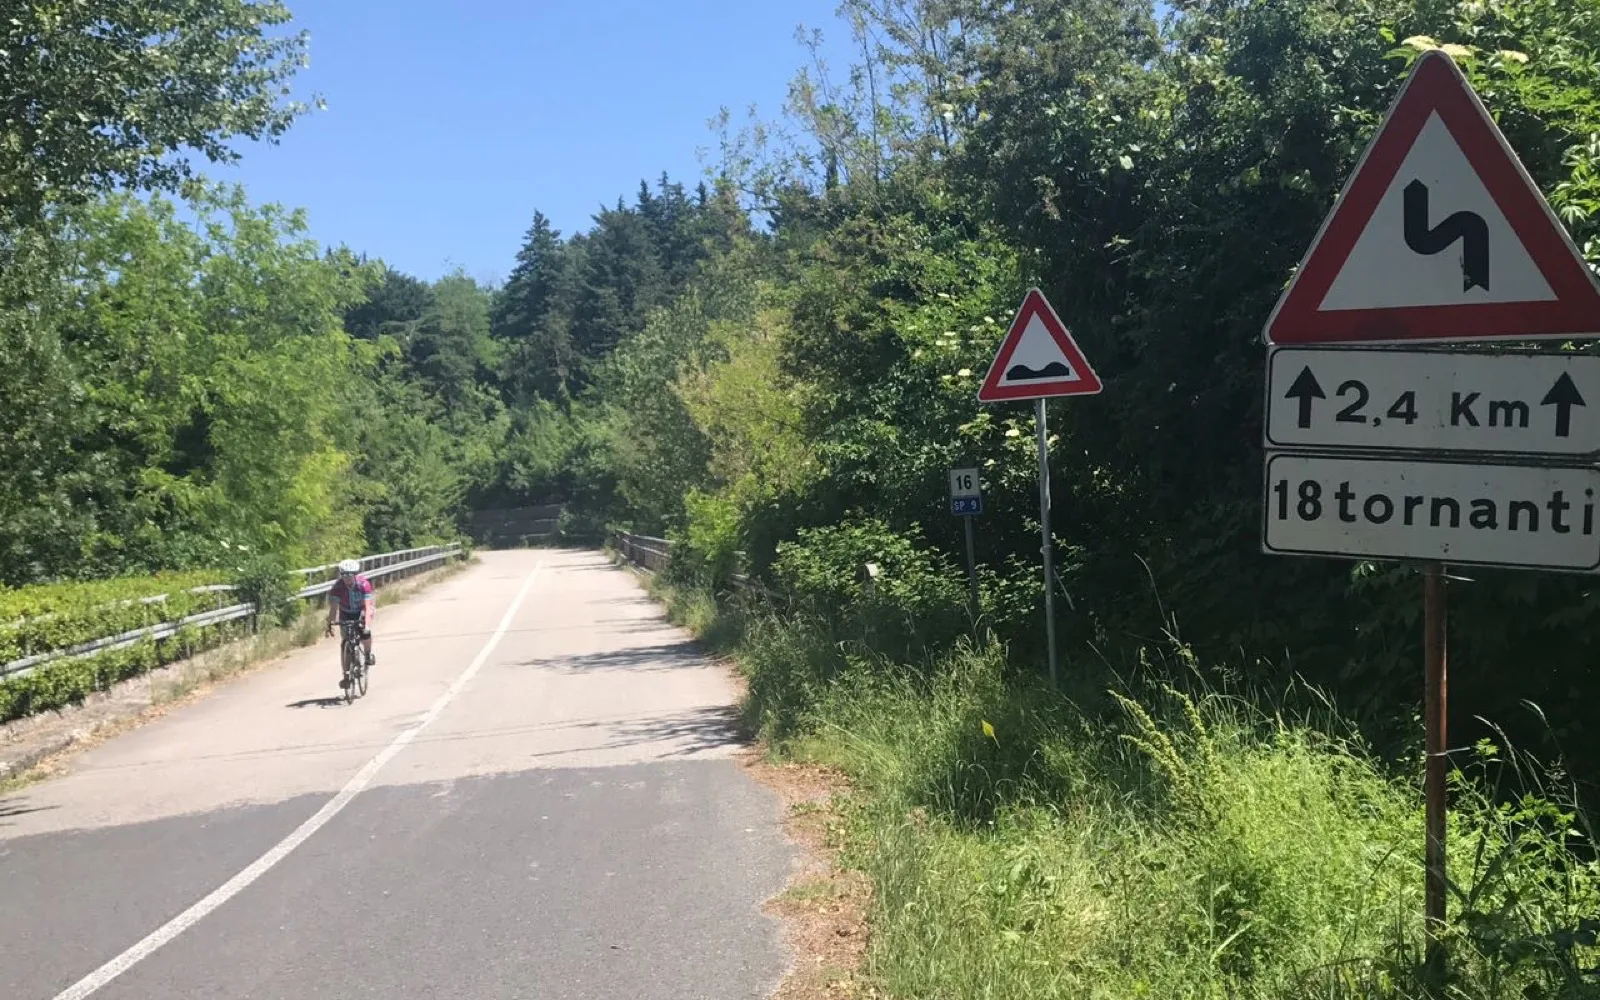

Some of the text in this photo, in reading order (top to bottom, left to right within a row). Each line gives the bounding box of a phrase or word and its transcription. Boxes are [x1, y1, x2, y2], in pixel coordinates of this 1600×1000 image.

[1335, 379, 1530, 428] 2,4 Km
[956, 474, 972, 490] 16
[953, 500, 977, 511] SP 9
[1273, 479, 1594, 535] 18 tornanti
